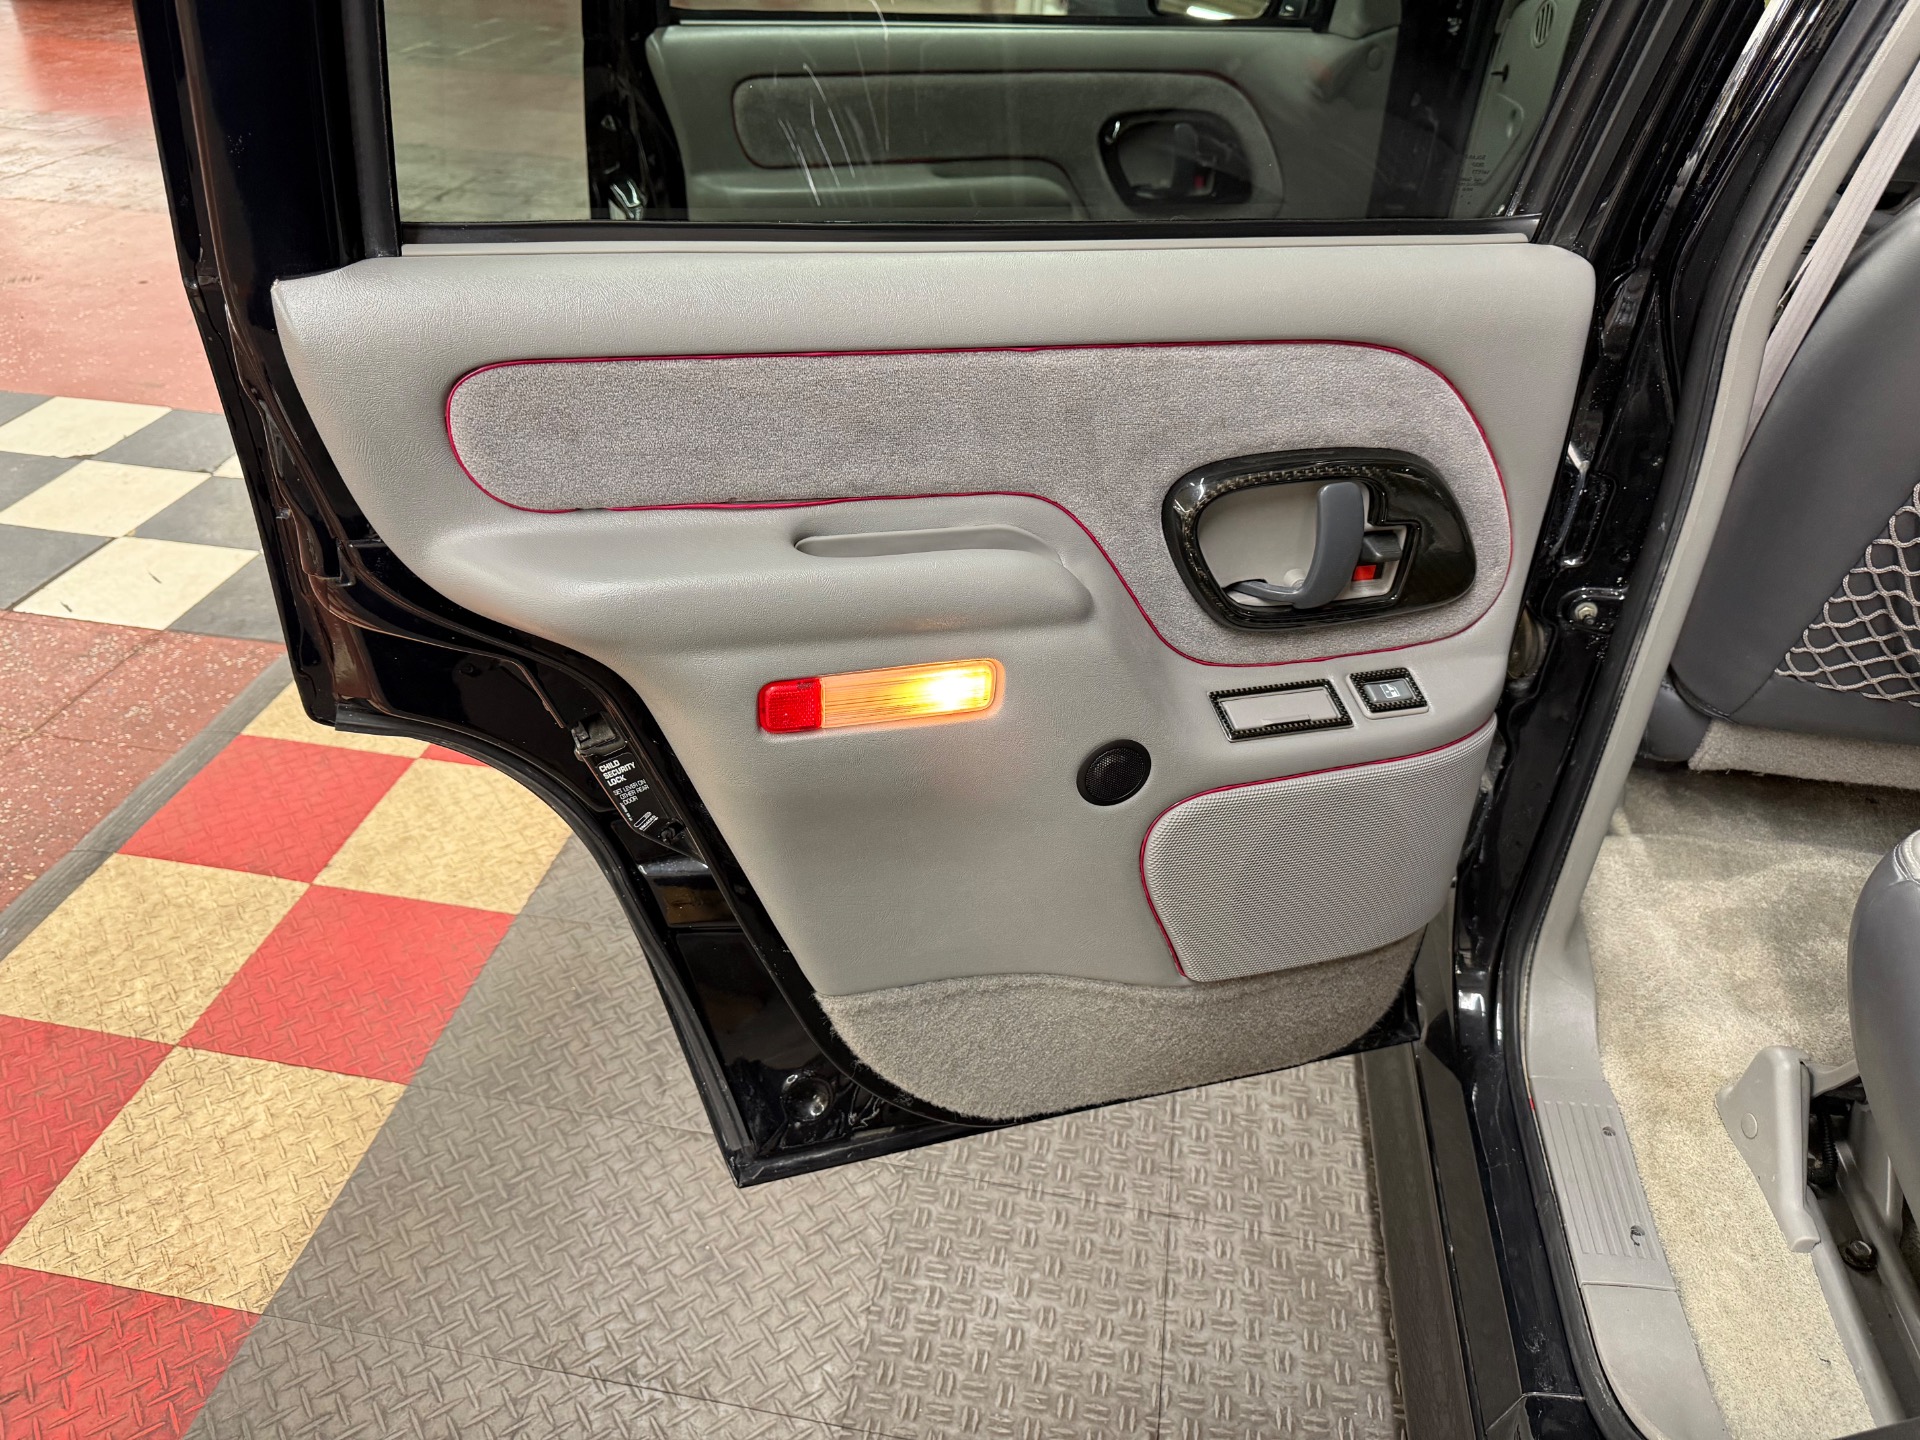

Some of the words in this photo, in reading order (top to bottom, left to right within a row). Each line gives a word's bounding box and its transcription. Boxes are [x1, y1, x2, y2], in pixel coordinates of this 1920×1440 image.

[599, 760, 620, 772] CHILD
[603, 762, 635, 779] SECURITY
[607, 775, 627, 786] LOCK
[620, 790, 636, 799] OTHER
[636, 785, 649, 793] REAR
[623, 796, 638, 805] DOOR
